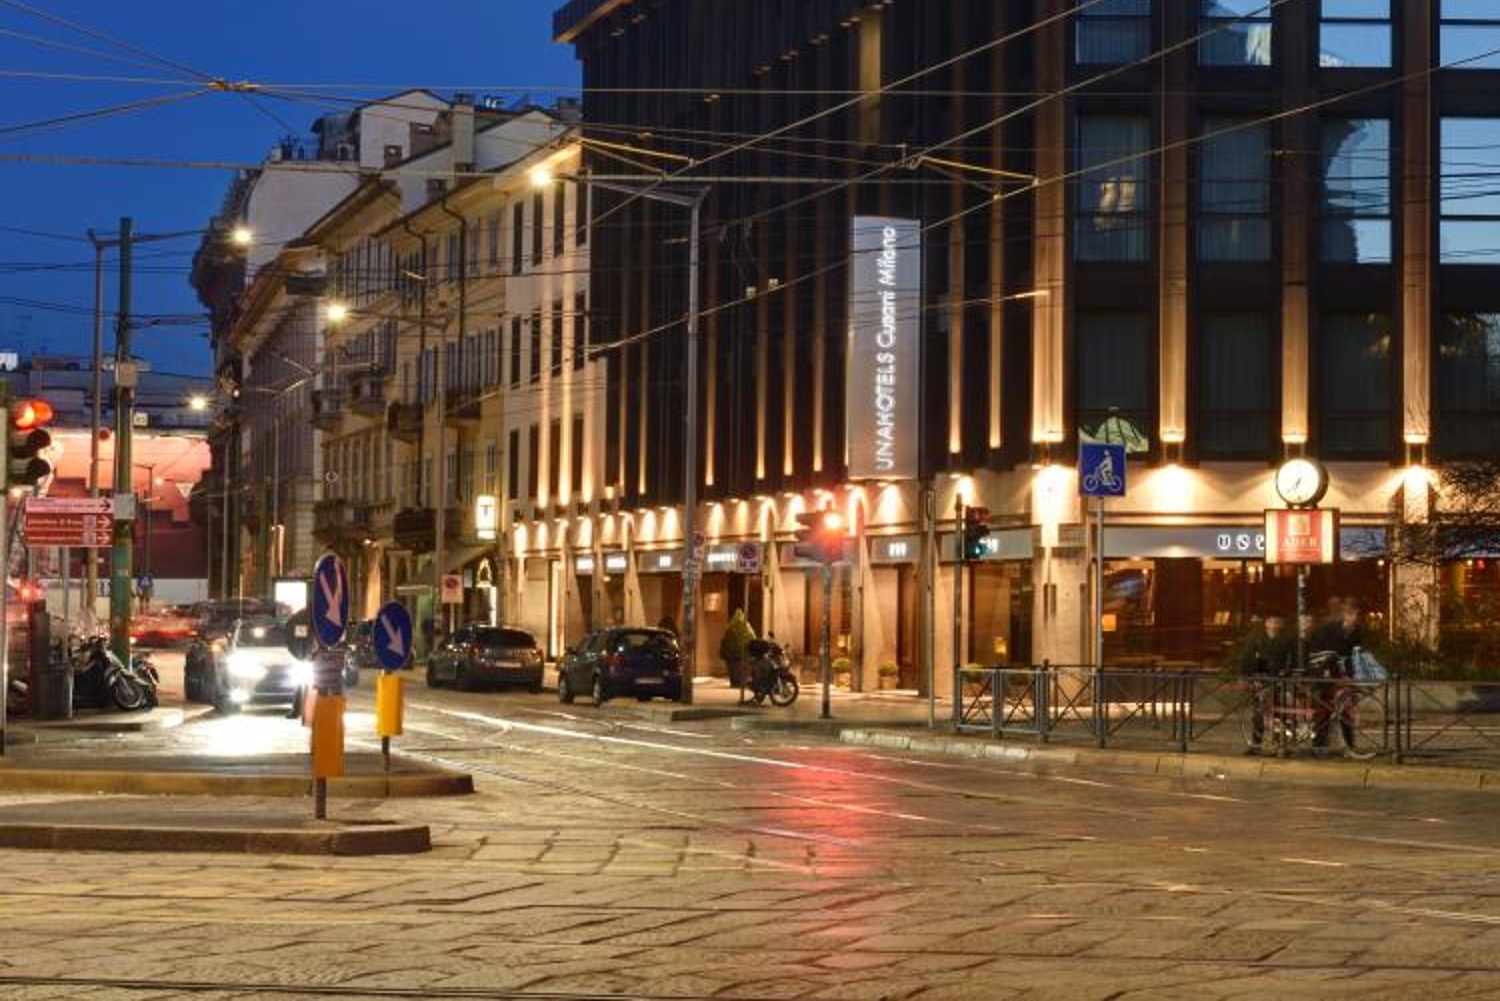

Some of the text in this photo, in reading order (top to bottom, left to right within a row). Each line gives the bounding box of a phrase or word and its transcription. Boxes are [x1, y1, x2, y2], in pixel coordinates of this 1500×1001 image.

[875, 226, 896, 471] UNAHOTELS Cusani Milano
